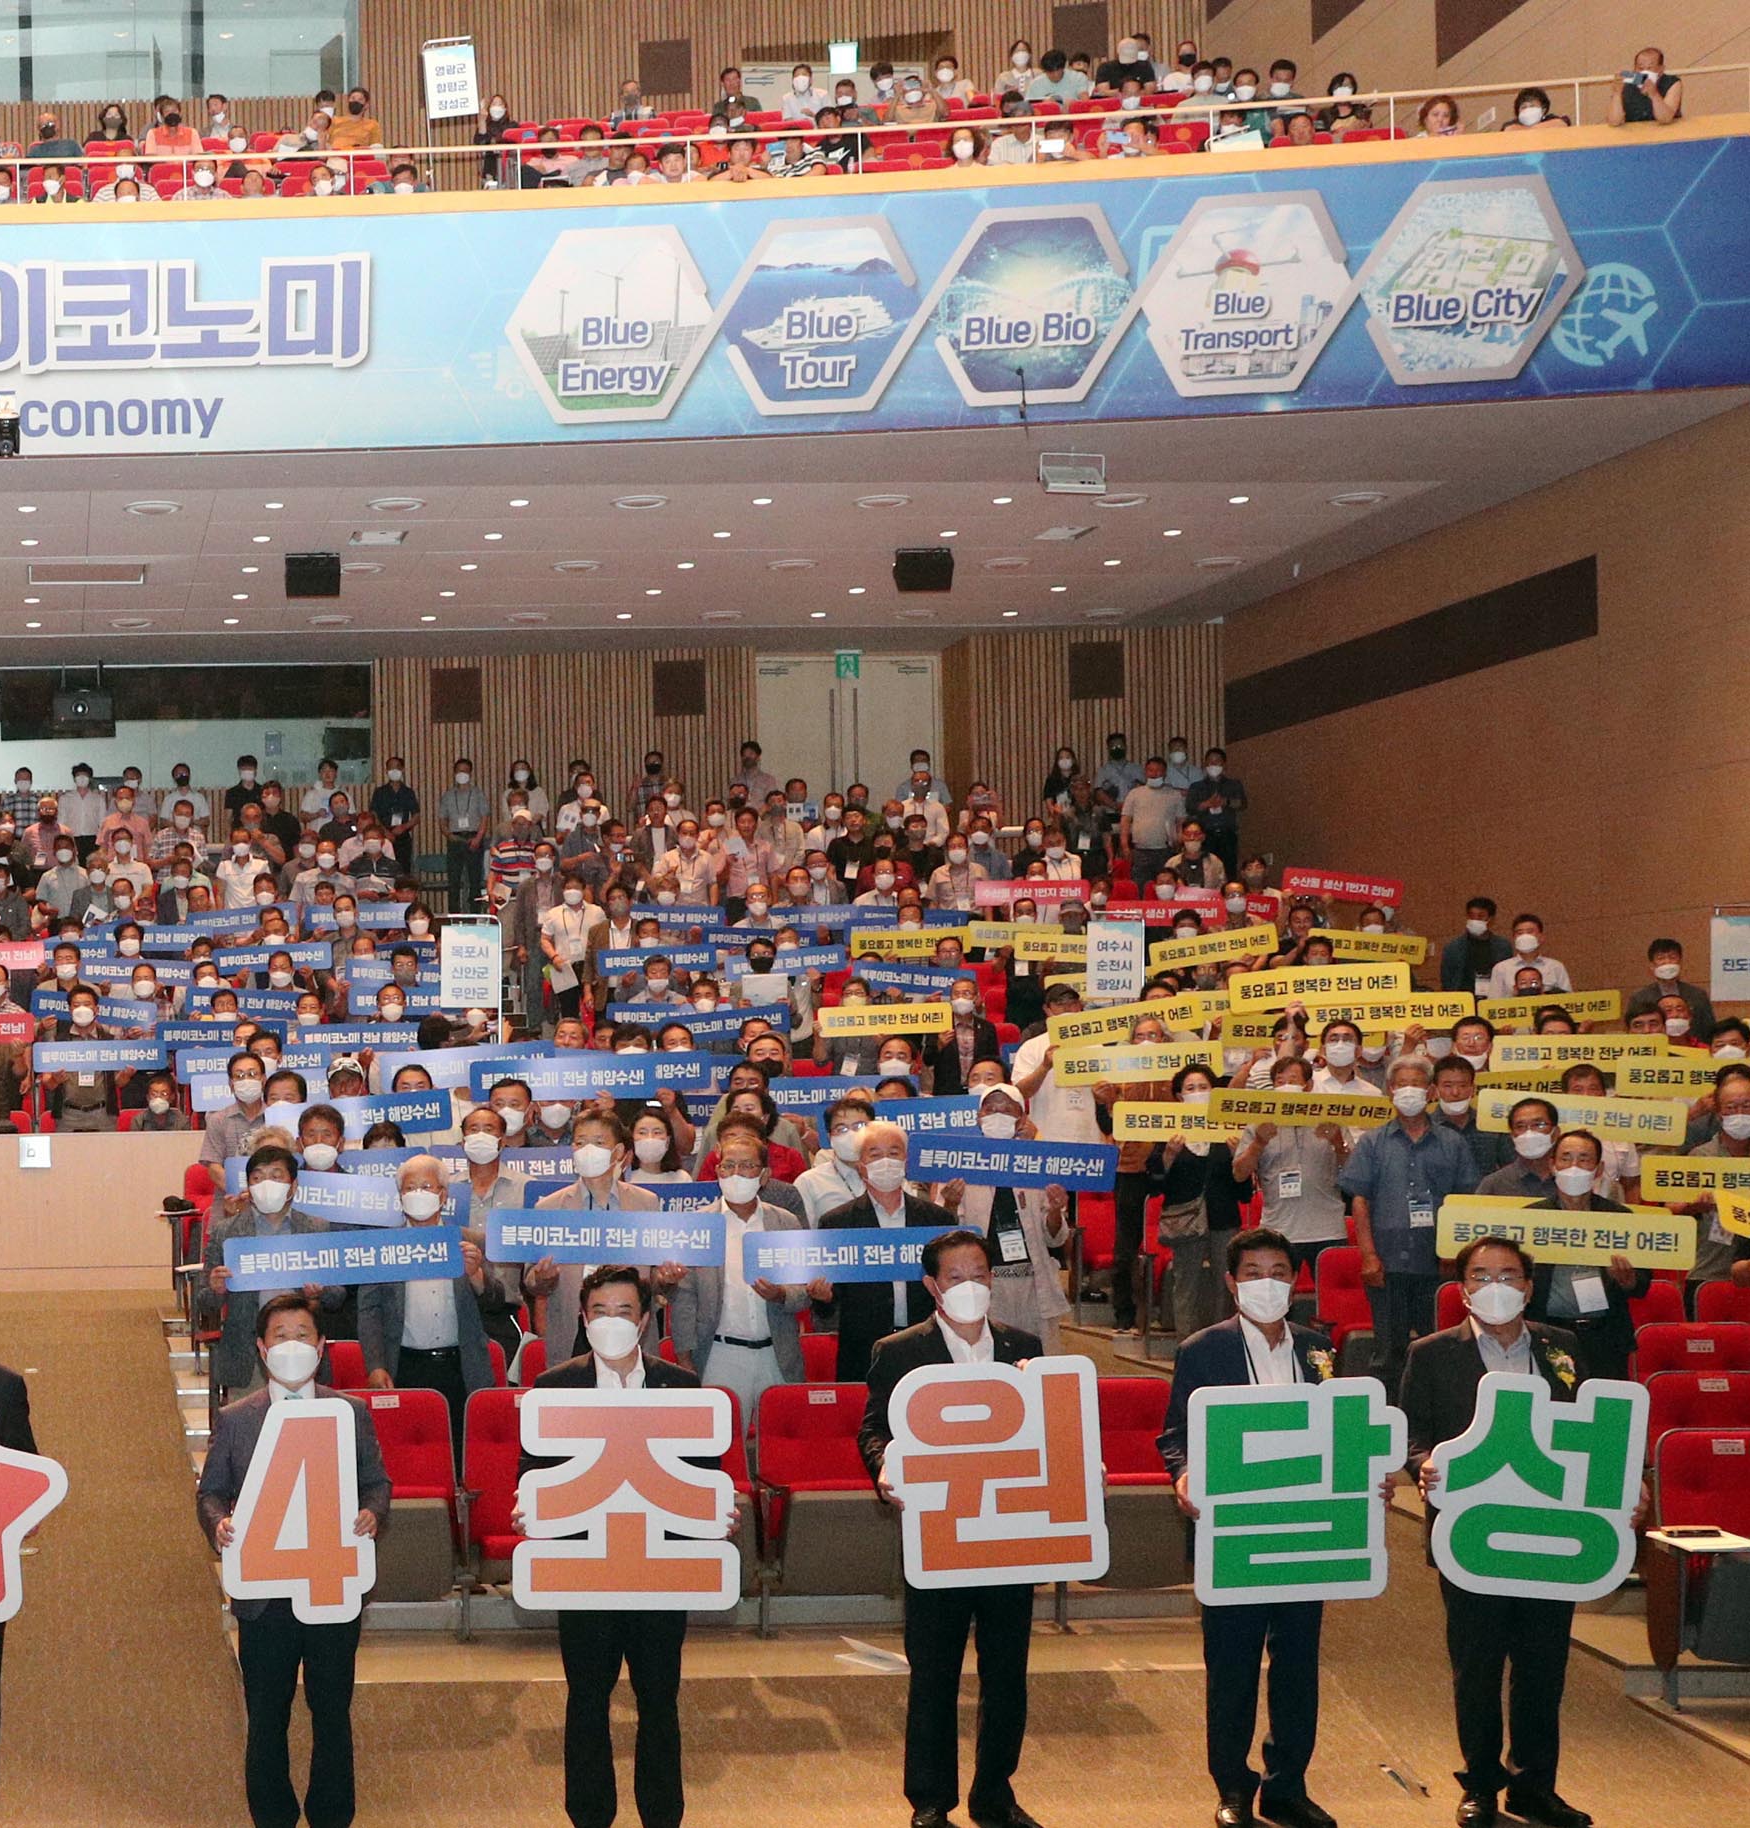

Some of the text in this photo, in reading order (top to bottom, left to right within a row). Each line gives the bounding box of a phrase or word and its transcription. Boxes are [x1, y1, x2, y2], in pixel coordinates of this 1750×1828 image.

[1213, 291, 1265, 315] Blue
[1393, 287, 1539, 325] Blue City
[583, 317, 650, 347] Blue
[785, 310, 852, 341] Blue
[964, 313, 1093, 347] Blue Bio
[1180, 321, 1296, 354] Transport
[561, 360, 667, 396] Energy
[783, 355, 852, 388] Tour
[451, 946, 489, 959] 목포시
[1097, 940, 1132, 952] 여수시
[1159, 946, 1195, 961] 풍요롭고
[1199, 941, 1227, 955] 행복한
[451, 965, 489, 979] 신안군
[1722, 958, 1750, 972] 진도
[451, 987, 489, 1000] 무안군
[1097, 979, 1132, 991] 광양시
[1241, 975, 1398, 999] 풍요롭고 행복한 전남 어촌!
[1316, 1006, 1365, 1022] 풍요롭고
[563, 1069, 644, 1086] 전남 해양수산!
[1064, 1059, 1110, 1074] 풍요롭고
[361, 1102, 440, 1125] 전남 해양수산!
[1221, 1100, 1276, 1114] 풍요롭고
[1281, 1102, 1324, 1116] 행복한
[919, 1112, 946, 1131] 전남
[919, 1150, 1103, 1177] 블루이코노미! 전남 해양수산!
[361, 1192, 386, 1211] 전남
[502, 1226, 710, 1249] 블루이코노미! 전남 해양수산!
[1533, 1227, 1587, 1248] 행복한
[1593, 1229, 1630, 1249] 전남
[1637, 1231, 1678, 1252] 어촌!
[240, 1242, 448, 1274] 블루이코노미! 전남 해양수산!
[864, 1245, 894, 1263] 전남
[240, 1416, 358, 1606] 4
[530, 1406, 723, 1592] 조
[902, 1373, 1092, 1571] 원
[1205, 1394, 1392, 1589] 달
[1446, 1389, 1638, 1584] 성
